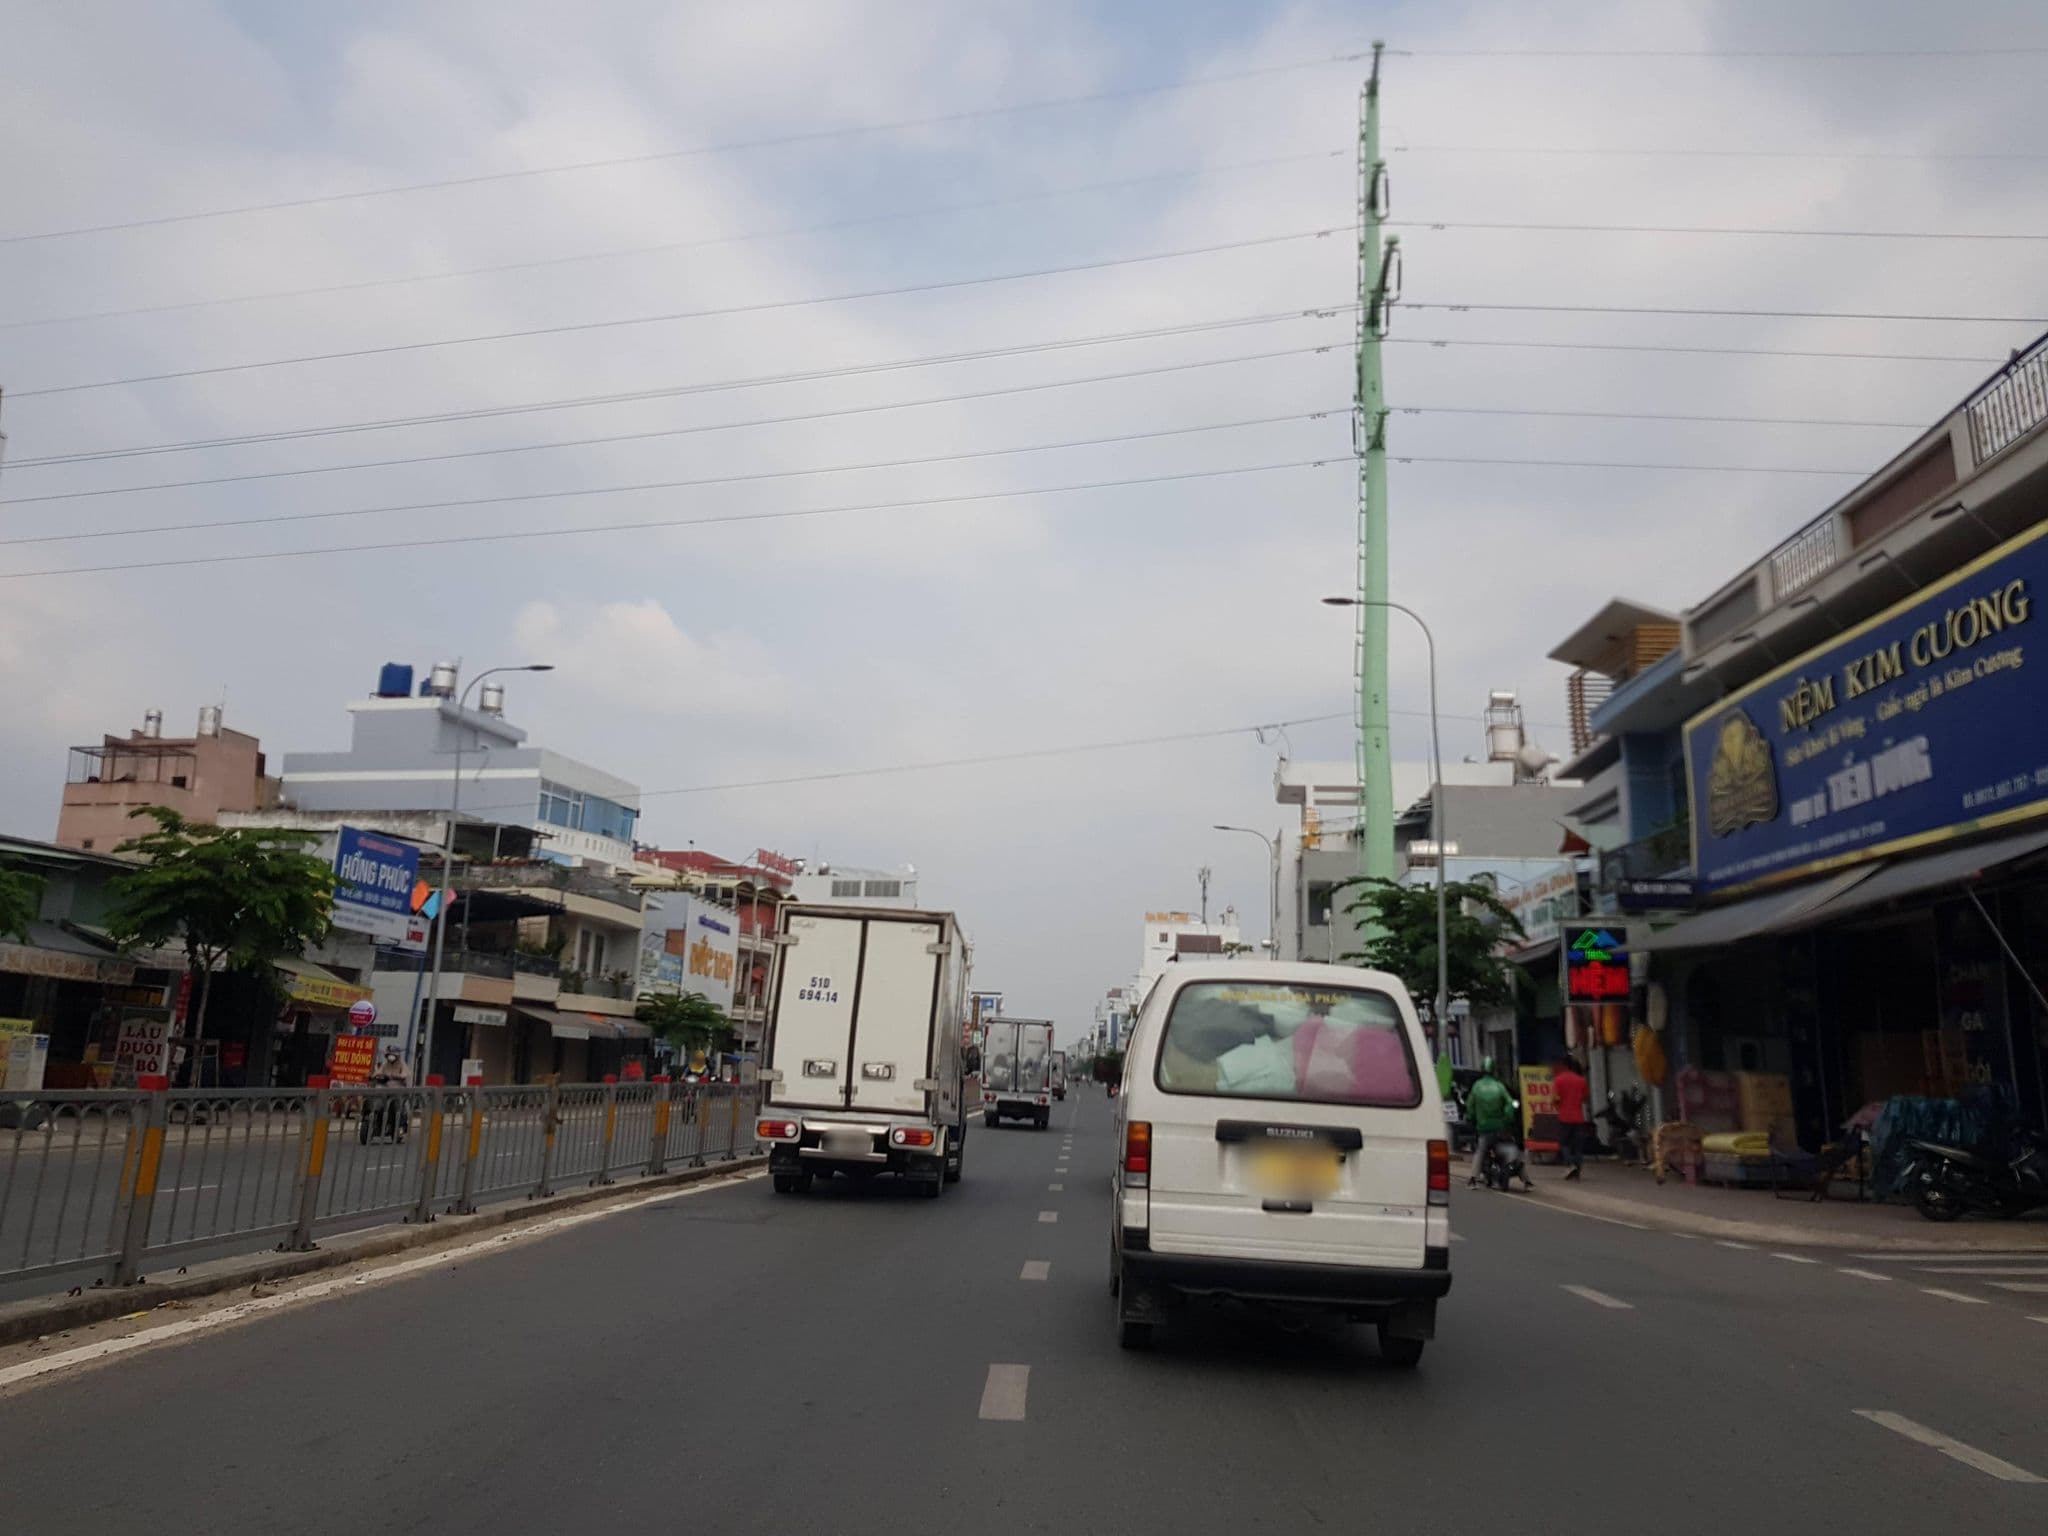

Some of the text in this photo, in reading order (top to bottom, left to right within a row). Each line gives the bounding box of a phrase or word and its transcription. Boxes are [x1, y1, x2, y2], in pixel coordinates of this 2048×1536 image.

[1779, 578, 2029, 732] NỆM KIM CƯƠNG
[798, 988, 838, 1003] 694.14
[119, 1038, 165, 1056] ĐUÔI
[1266, 1127, 1314, 1139] SUZUKI
